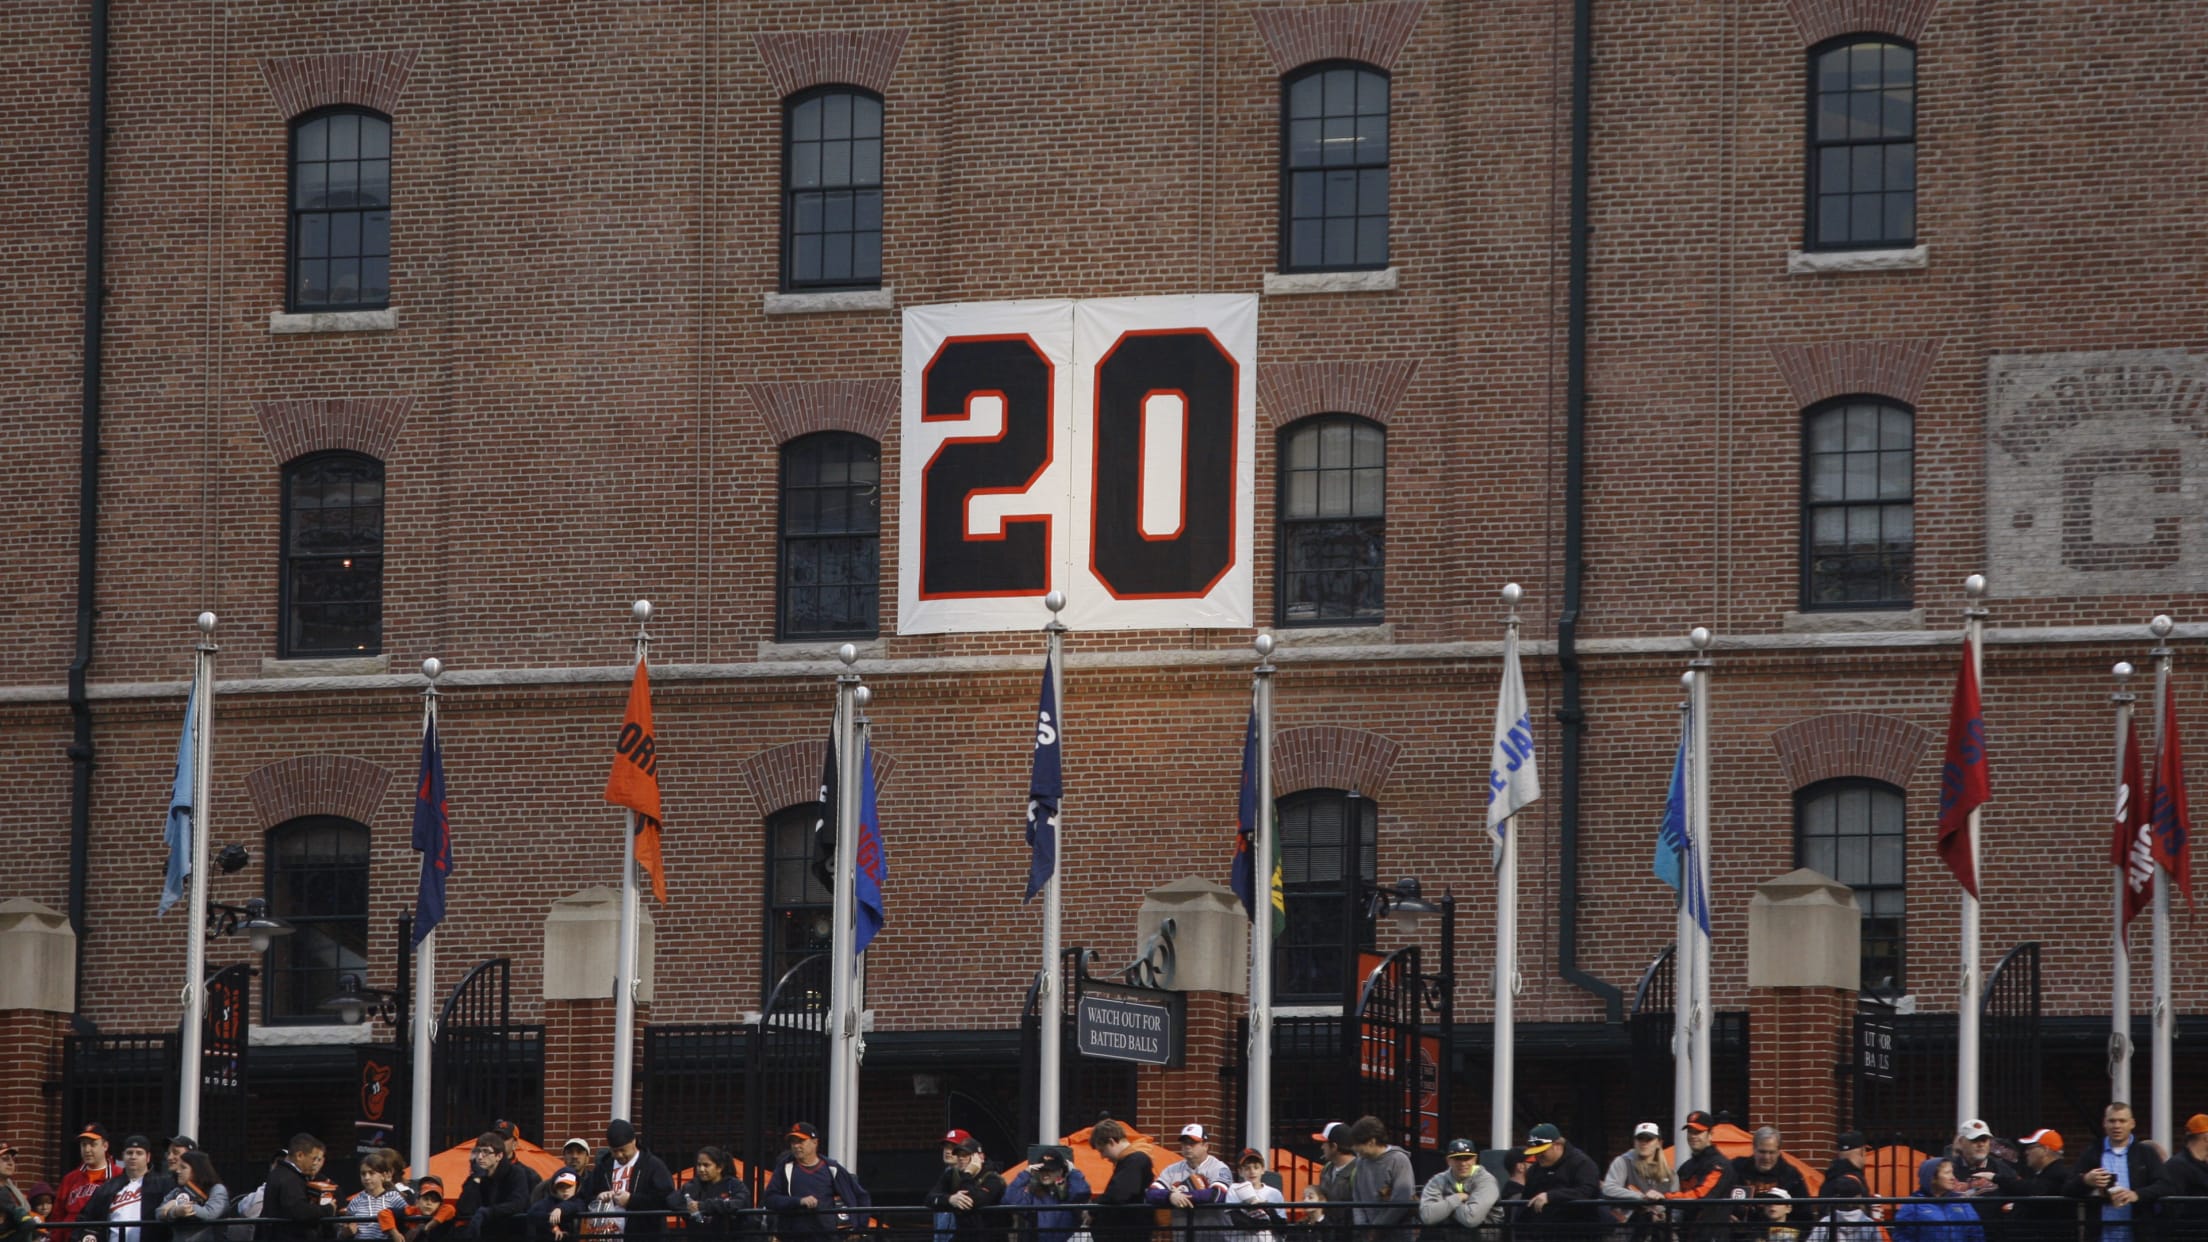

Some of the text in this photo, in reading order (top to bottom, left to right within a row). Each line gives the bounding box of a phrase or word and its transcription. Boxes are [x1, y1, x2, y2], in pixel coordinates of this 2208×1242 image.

[919, 327, 1240, 601] 20
[1087, 1006, 1162, 1032] WATCH OUT FOR
[1090, 1029, 1158, 1053] BATTED BALLS
[1865, 1051, 1889, 1070] BALS
